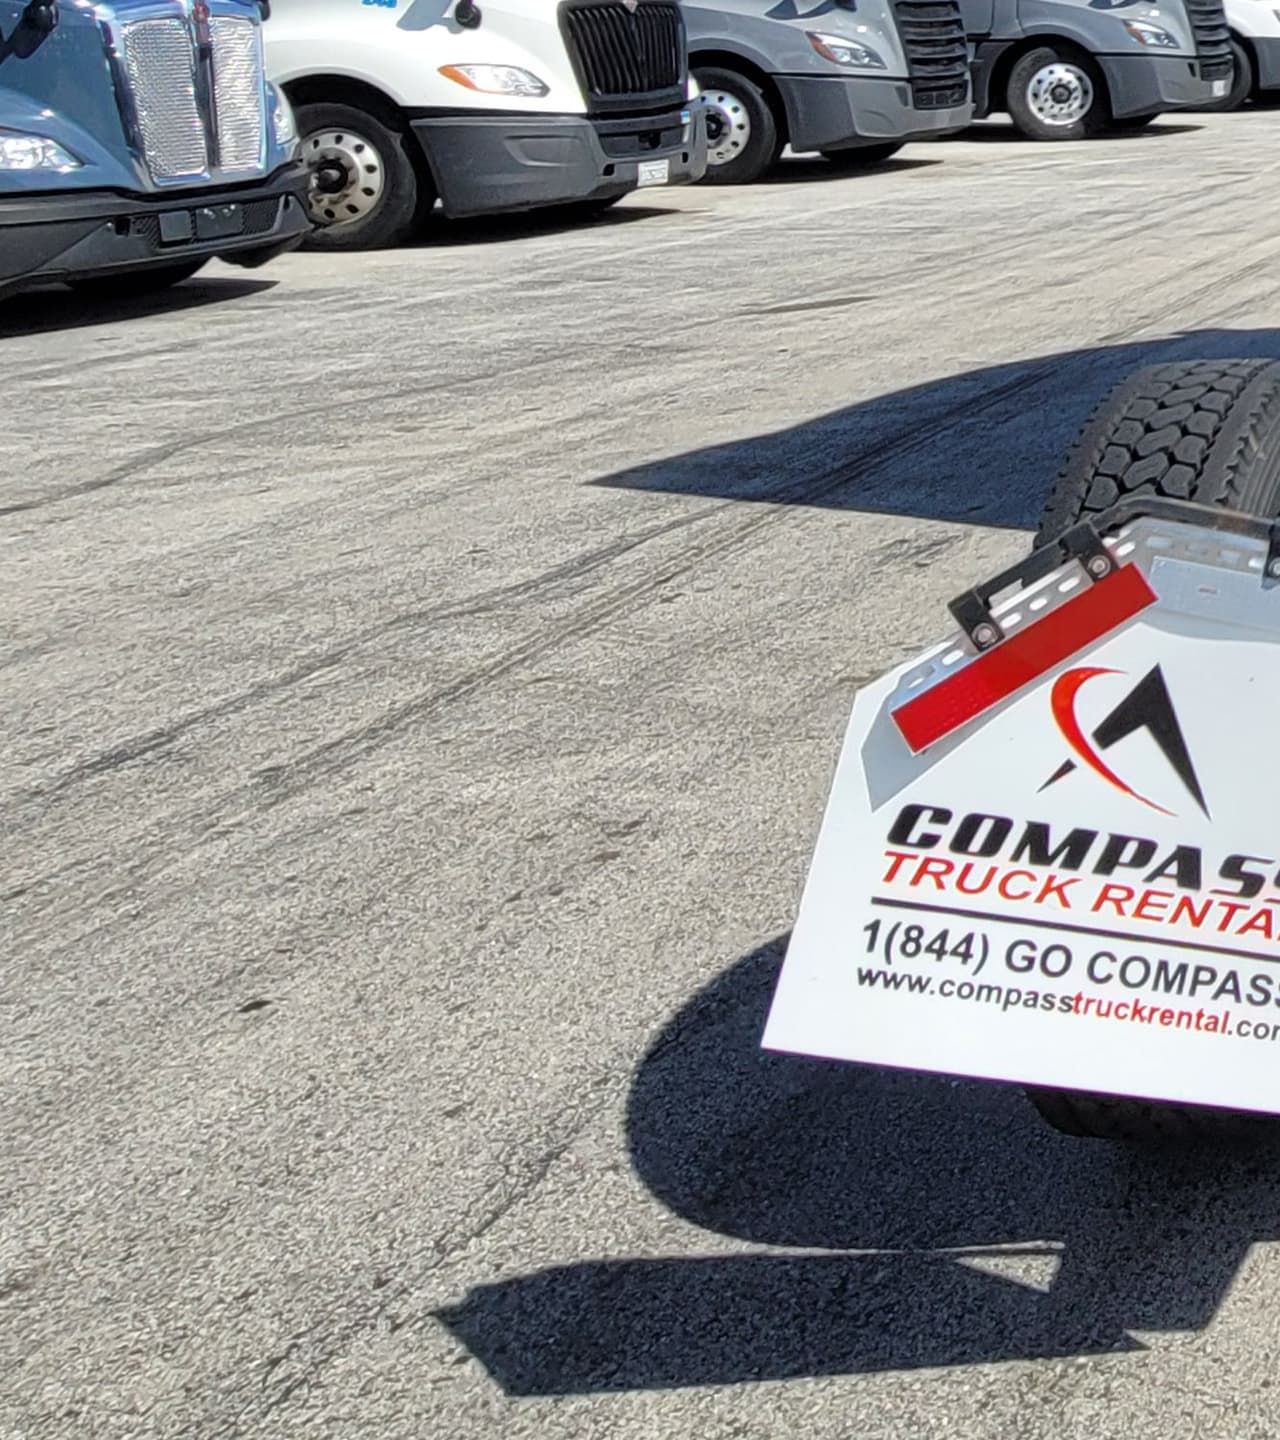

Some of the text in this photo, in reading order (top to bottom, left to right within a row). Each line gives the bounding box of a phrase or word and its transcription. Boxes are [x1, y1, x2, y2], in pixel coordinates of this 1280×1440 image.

[882, 851, 1083, 909] TRUCK
[863, 919, 989, 976] 1(844)
[1005, 939, 1072, 978] GO
